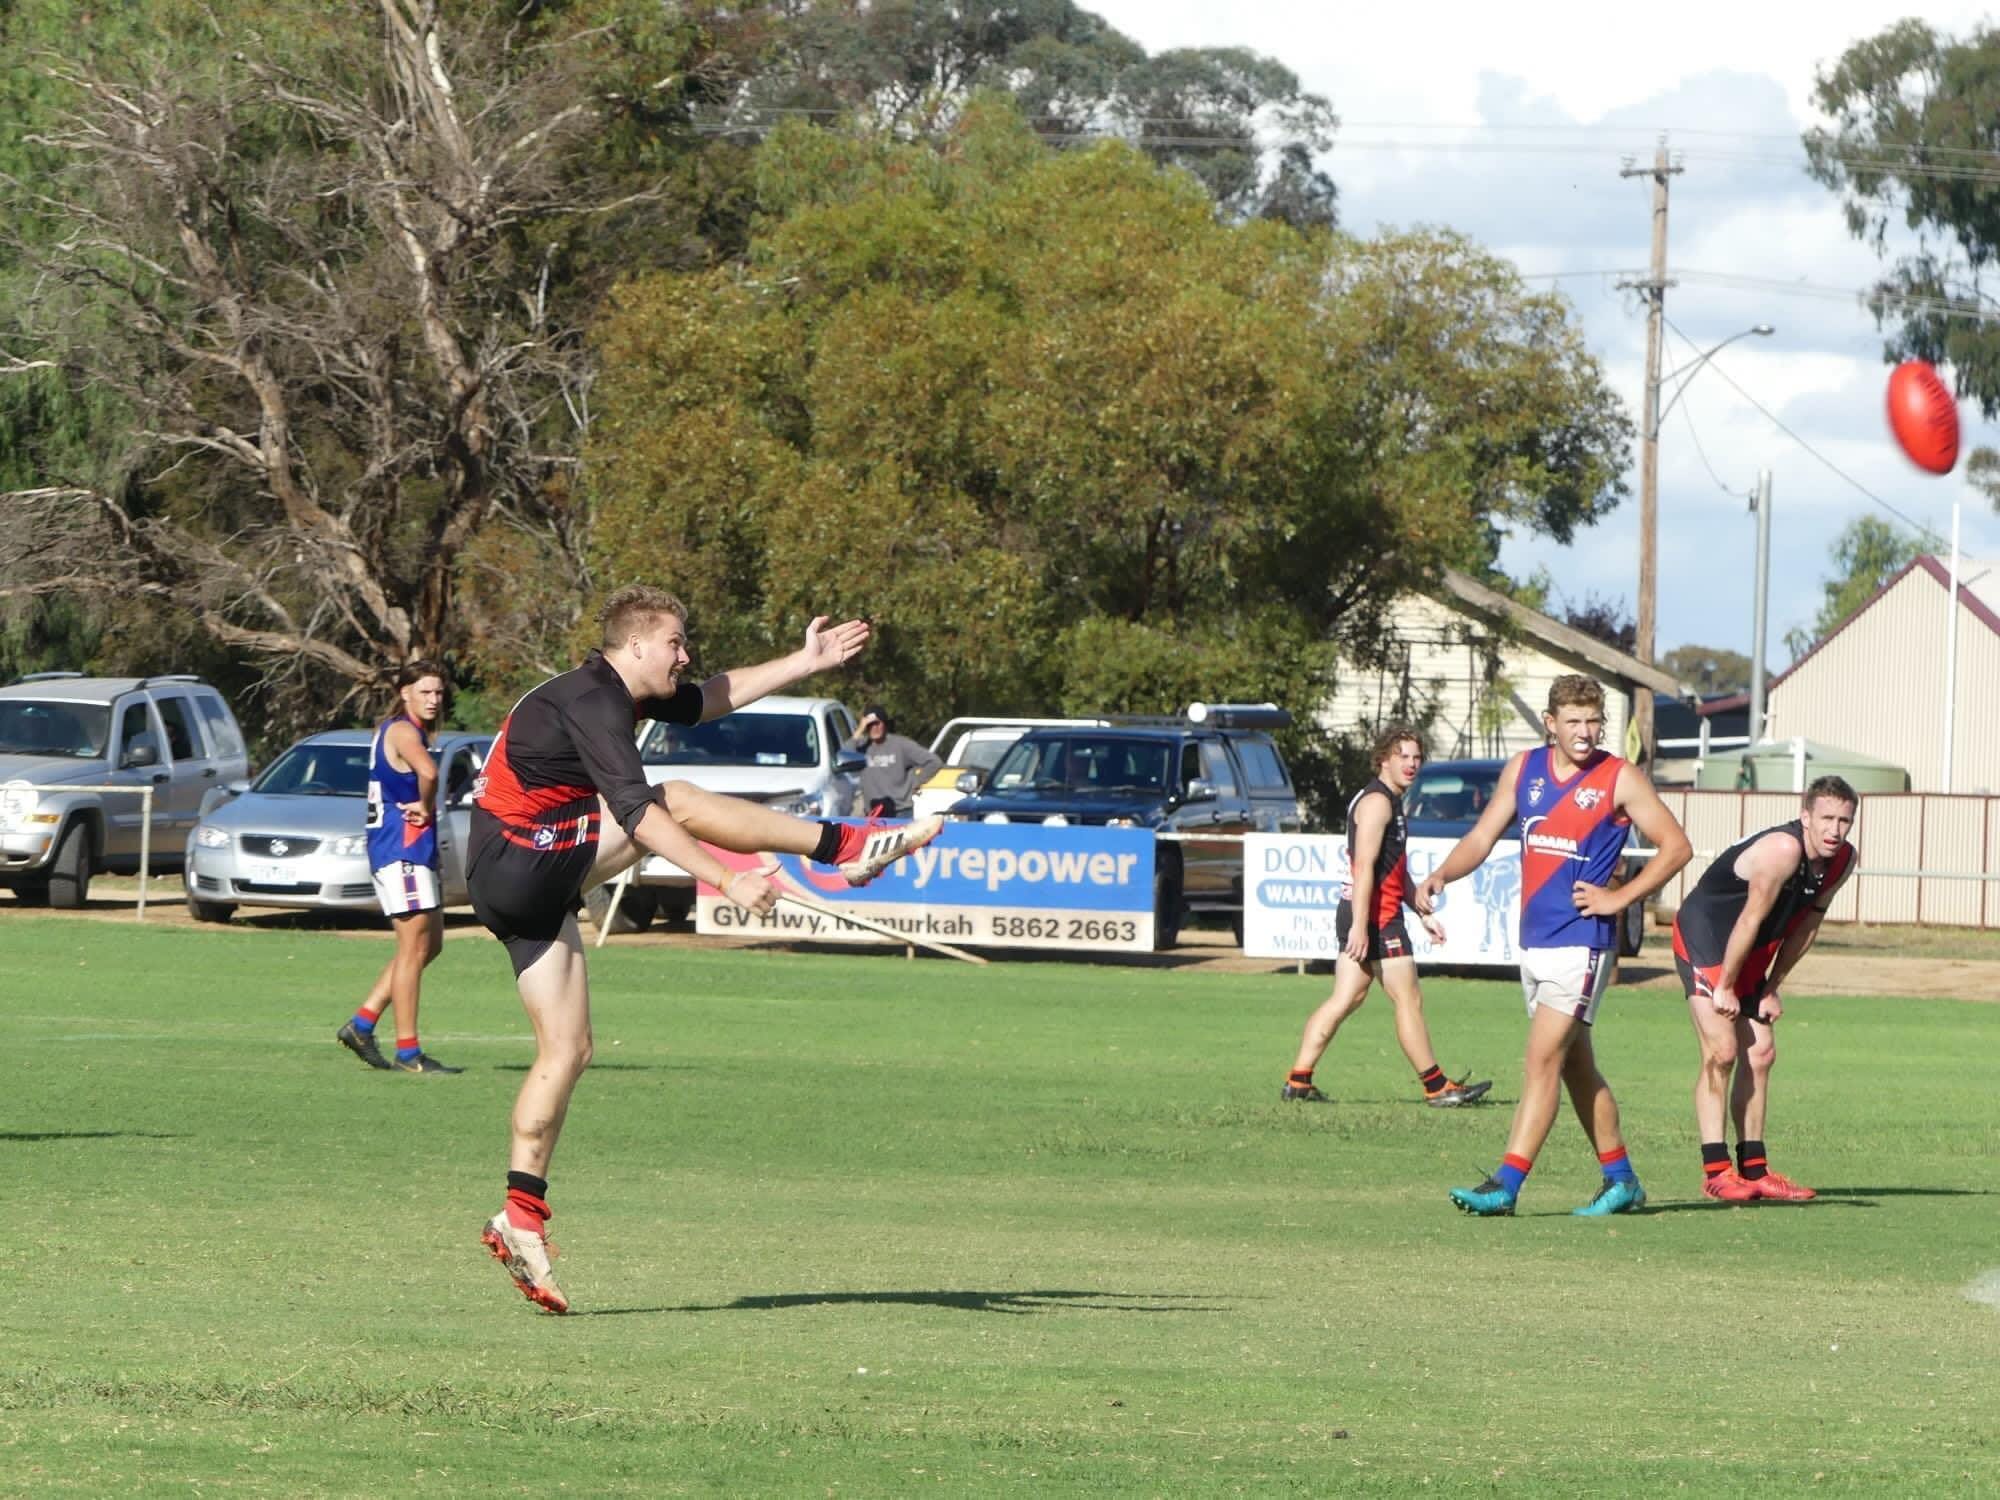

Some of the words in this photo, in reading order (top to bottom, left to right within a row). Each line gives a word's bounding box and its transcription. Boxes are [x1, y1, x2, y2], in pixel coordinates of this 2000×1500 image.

[1264, 845, 1327, 873] DON
[713, 905, 750, 927] GV
[992, 915, 1060, 939] 5862
[1067, 920, 1137, 942] 2663
